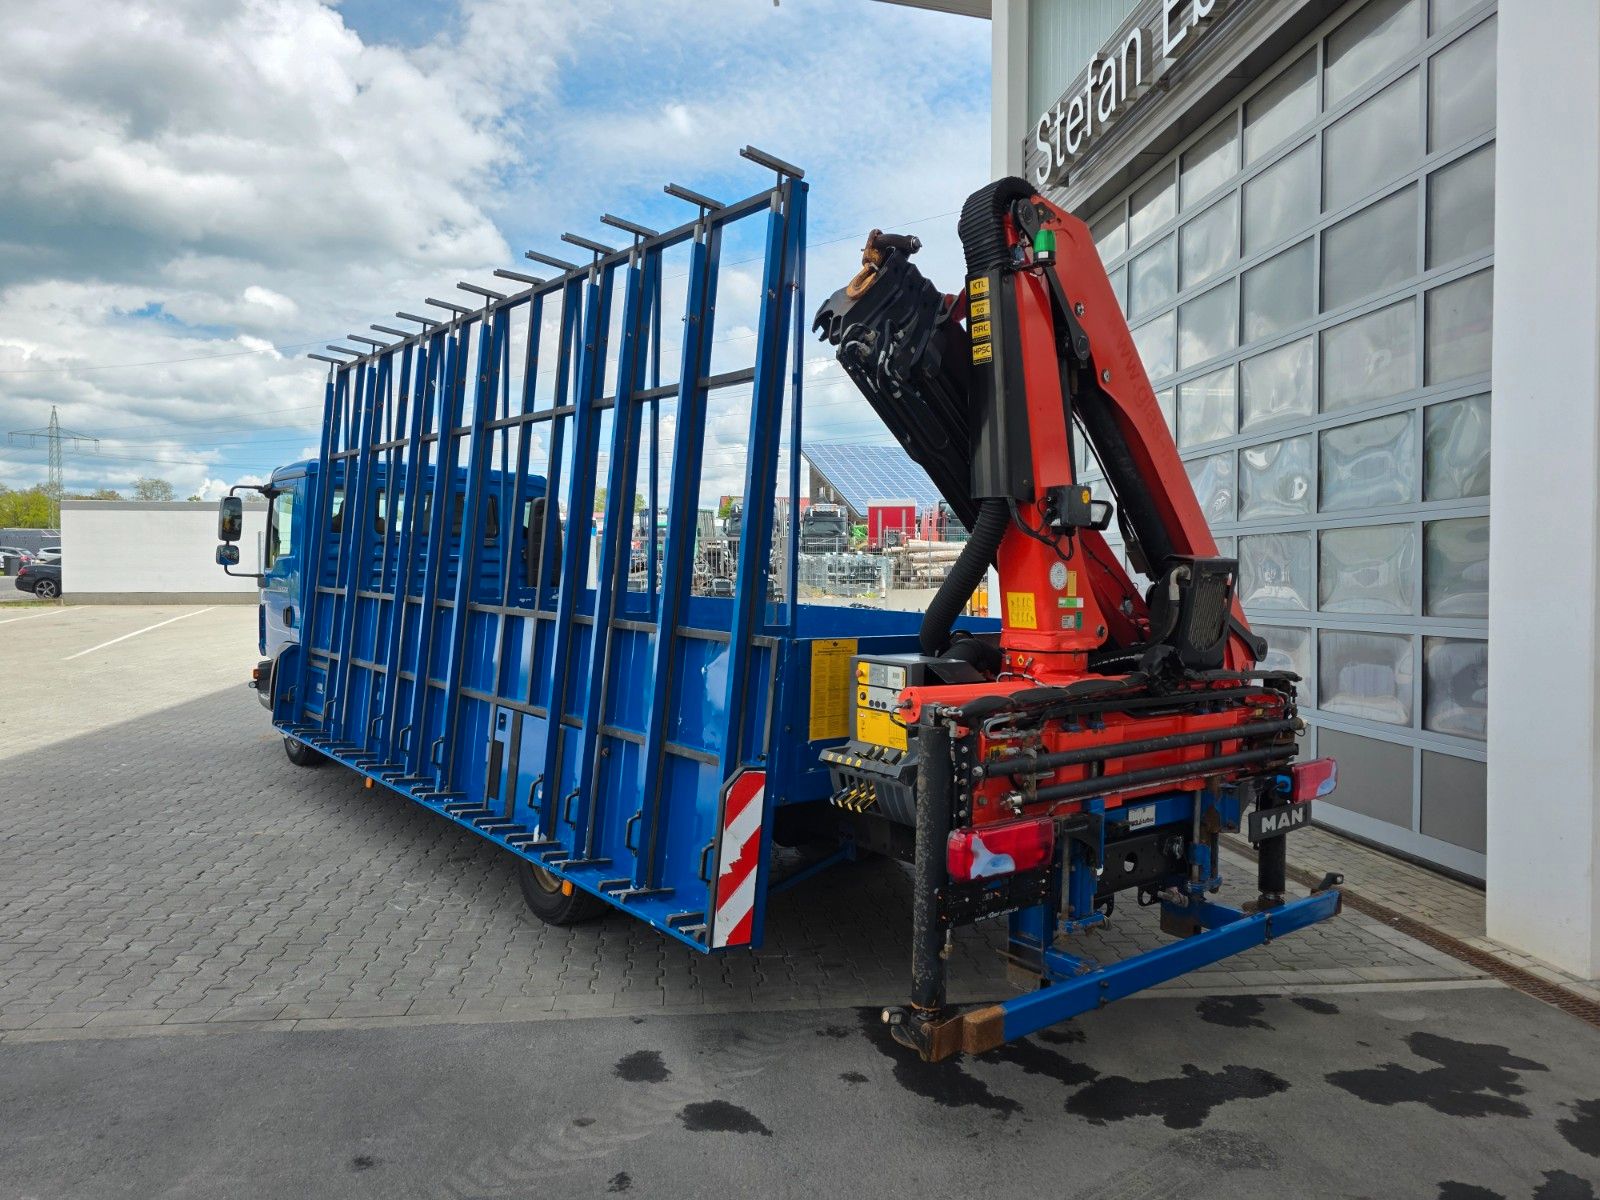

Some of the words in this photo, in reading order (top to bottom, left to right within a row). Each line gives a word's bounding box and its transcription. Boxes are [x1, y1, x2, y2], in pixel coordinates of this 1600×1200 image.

[1036, 27, 1142, 185] Stefan
[1163, 0, 1216, 58] E
[973, 346, 990, 355] HPSC
[1261, 807, 1303, 833] MAN
